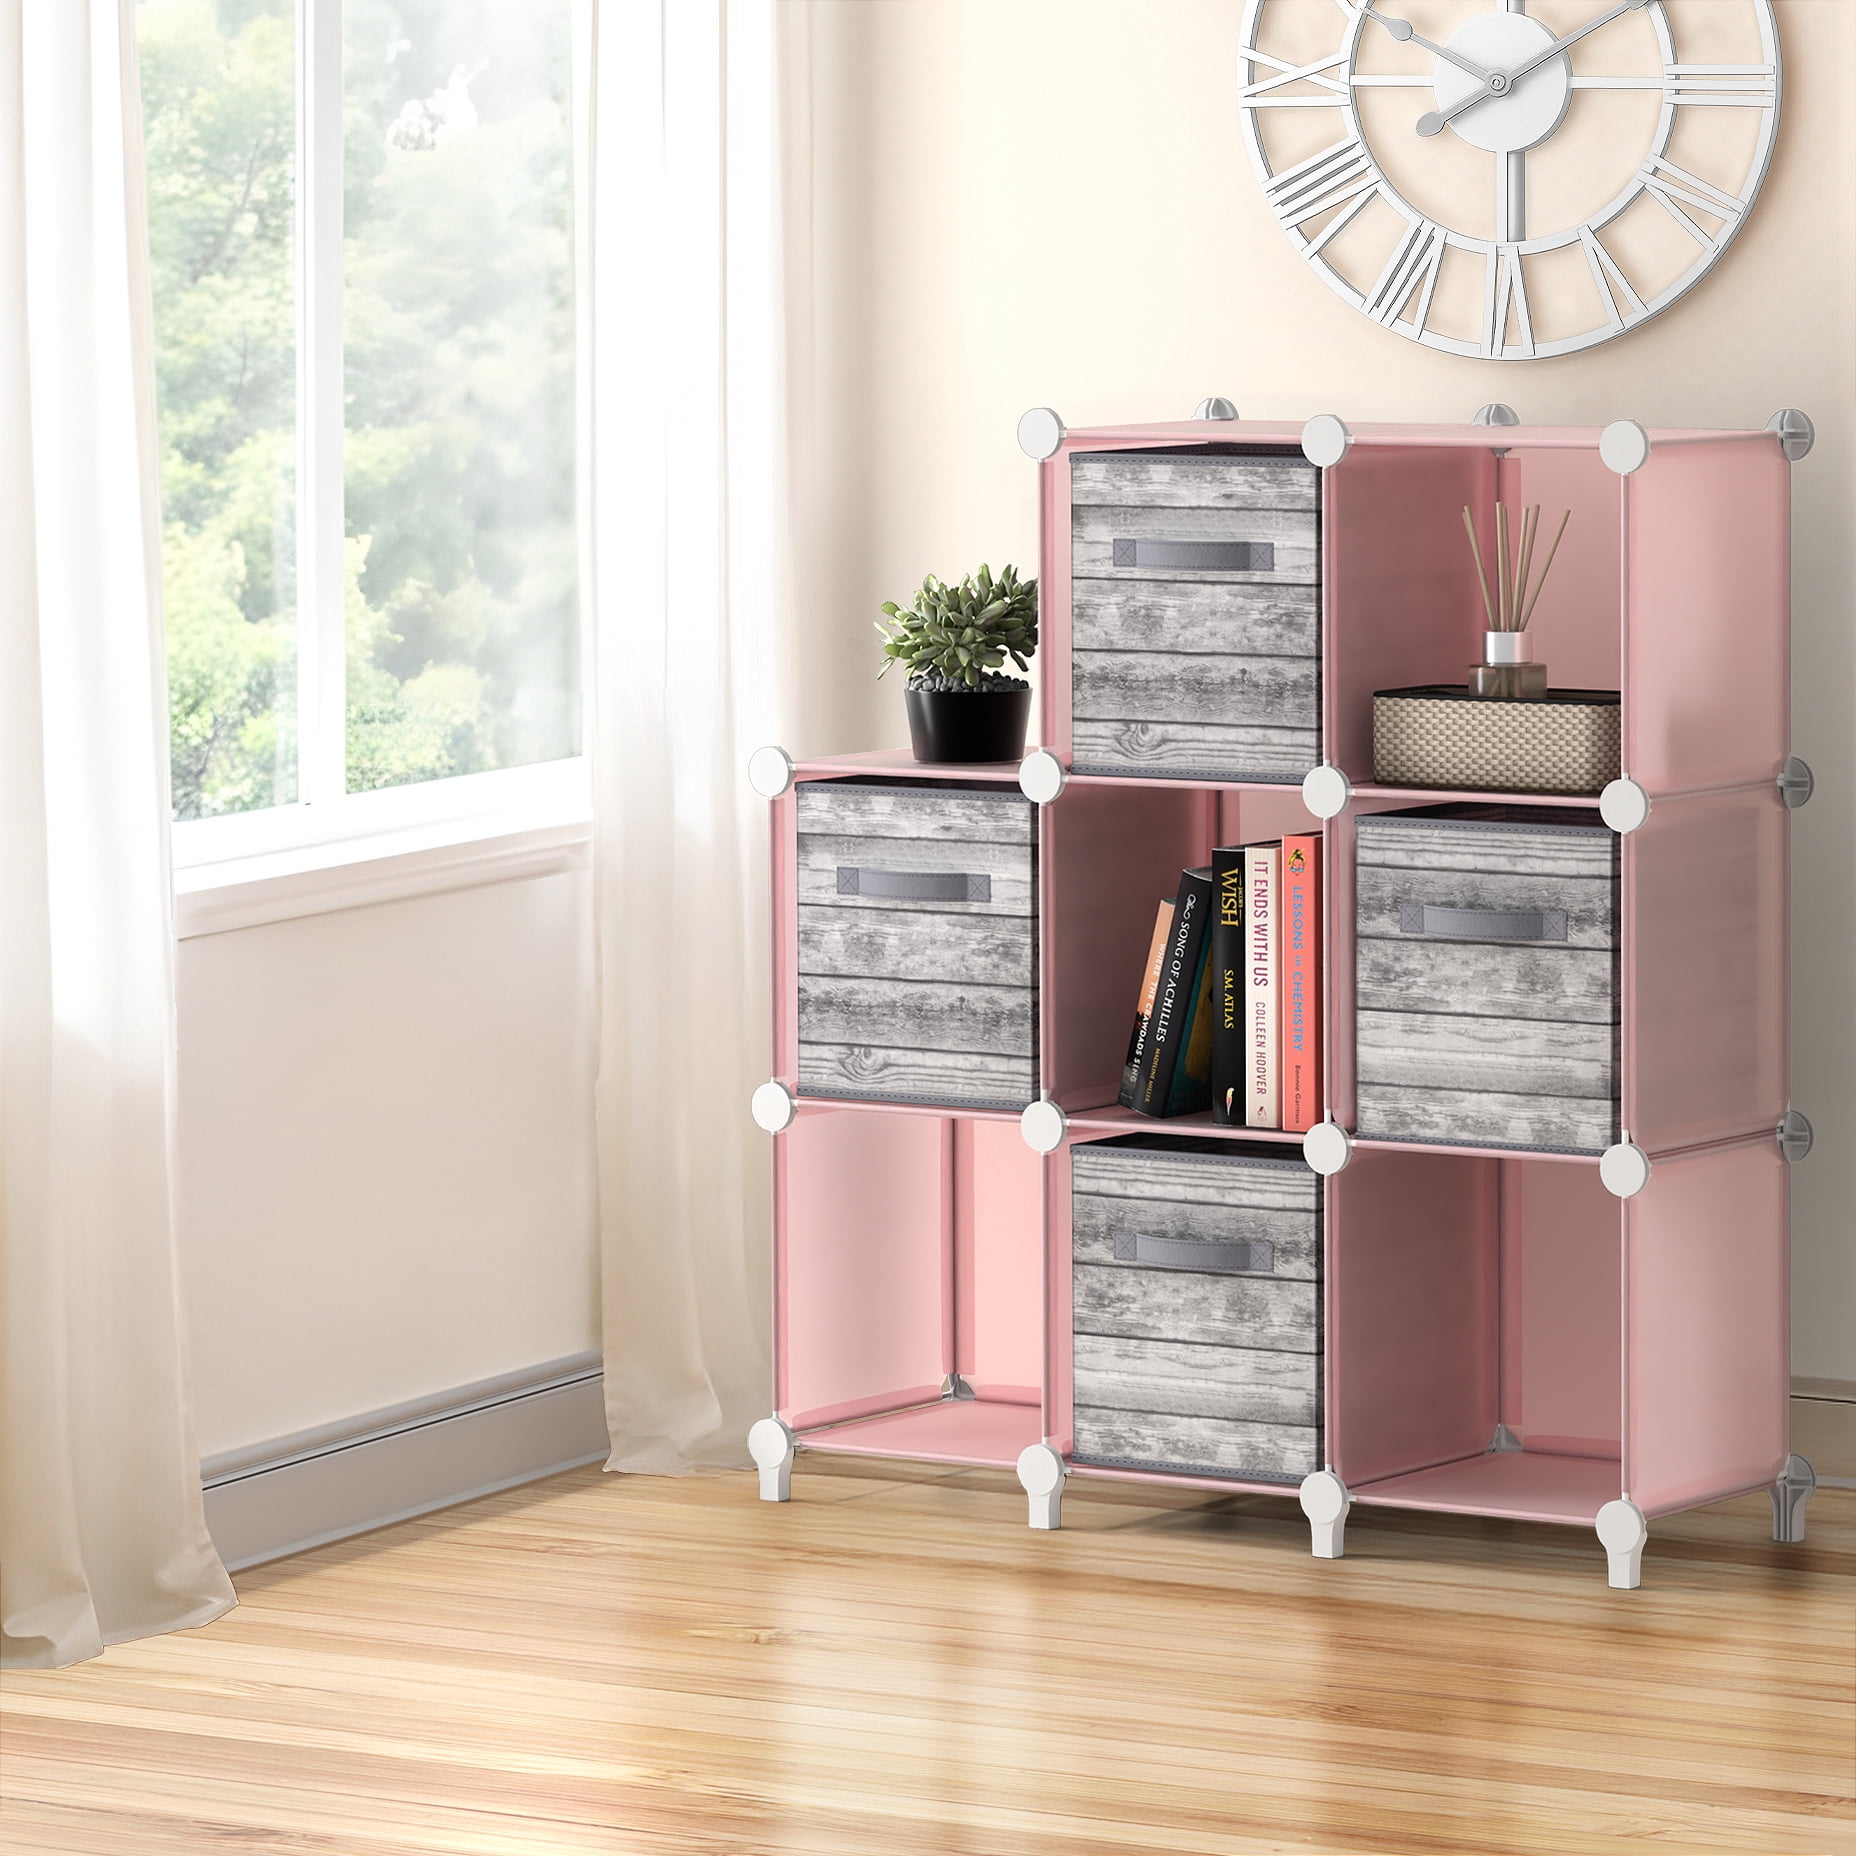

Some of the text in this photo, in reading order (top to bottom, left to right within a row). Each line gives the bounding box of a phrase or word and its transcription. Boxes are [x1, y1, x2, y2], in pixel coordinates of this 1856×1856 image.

[1221, 867, 1239, 927] WISH
[1253, 861, 1269, 987] IT ENDS WITH US
[1170, 960, 1182, 978] OF
[1174, 921, 1191, 957] SONG
[1293, 886, 1304, 1052] LESSONS in CHEMISTRY
[1129, 943, 1167, 1082] WHERE THE CRAWDADS SING
[1155, 978, 1177, 1043] ACHILLES
[1224, 993, 1235, 1030] ATLAS
[1255, 1001, 1268, 1095] COLLEEN HOOVER
